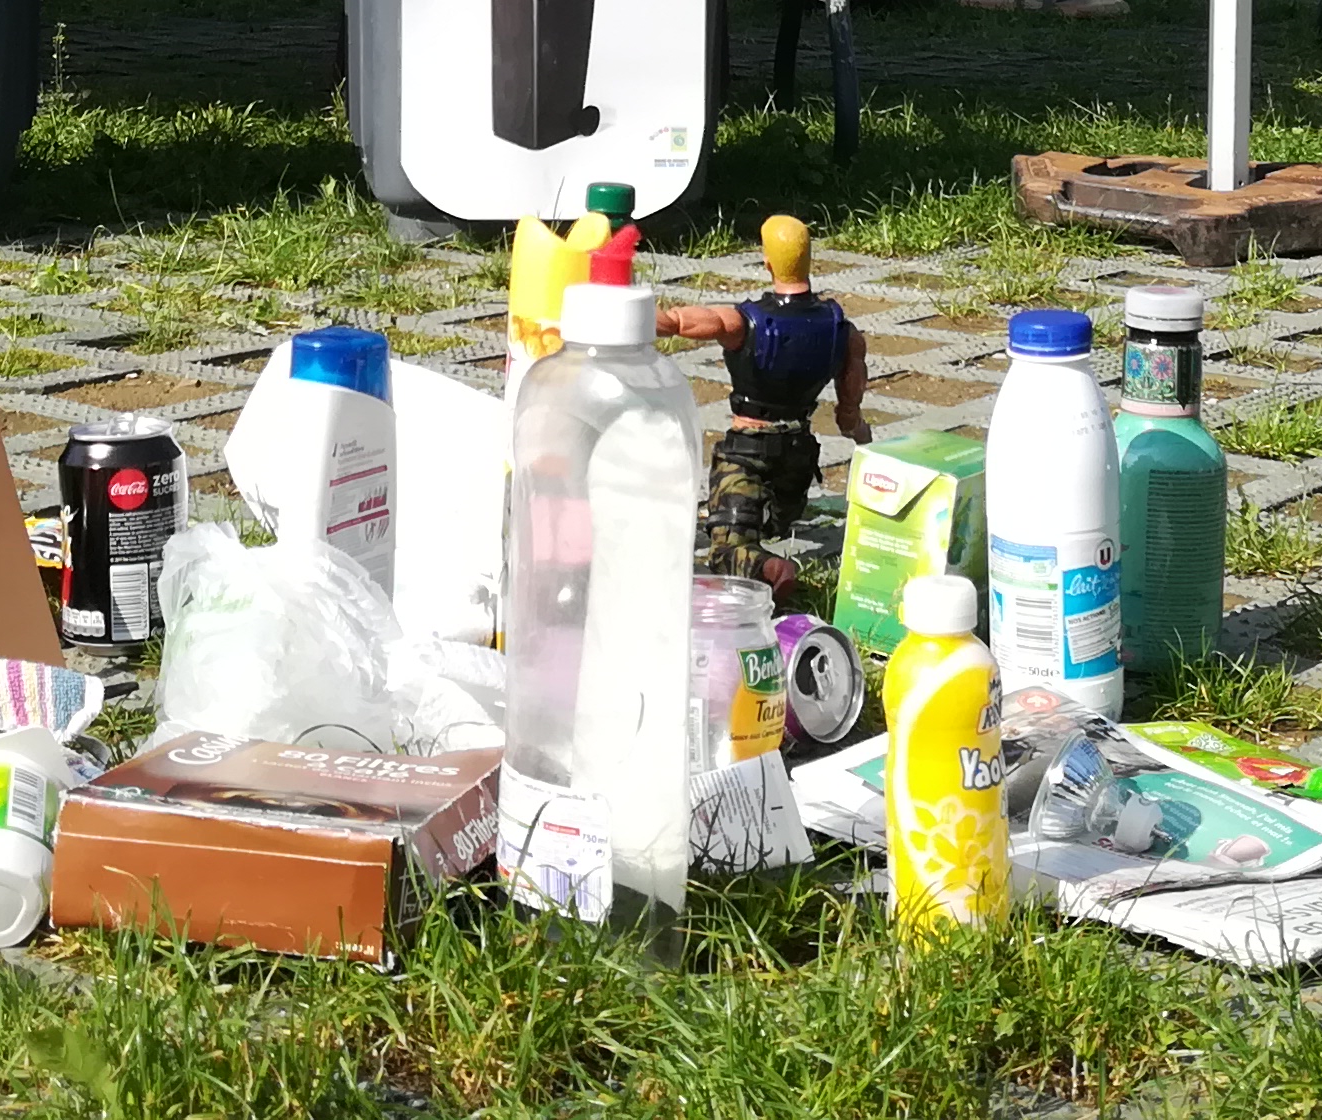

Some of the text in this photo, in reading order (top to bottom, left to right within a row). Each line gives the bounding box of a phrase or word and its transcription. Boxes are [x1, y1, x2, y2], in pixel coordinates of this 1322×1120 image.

[152, 470, 180, 487] zero
[1028, 667, 1039, 677] 50
[167, 730, 257, 766] Casin
[278, 750, 461, 777] 80 Filtres
[453, 830, 475, 861] 80
